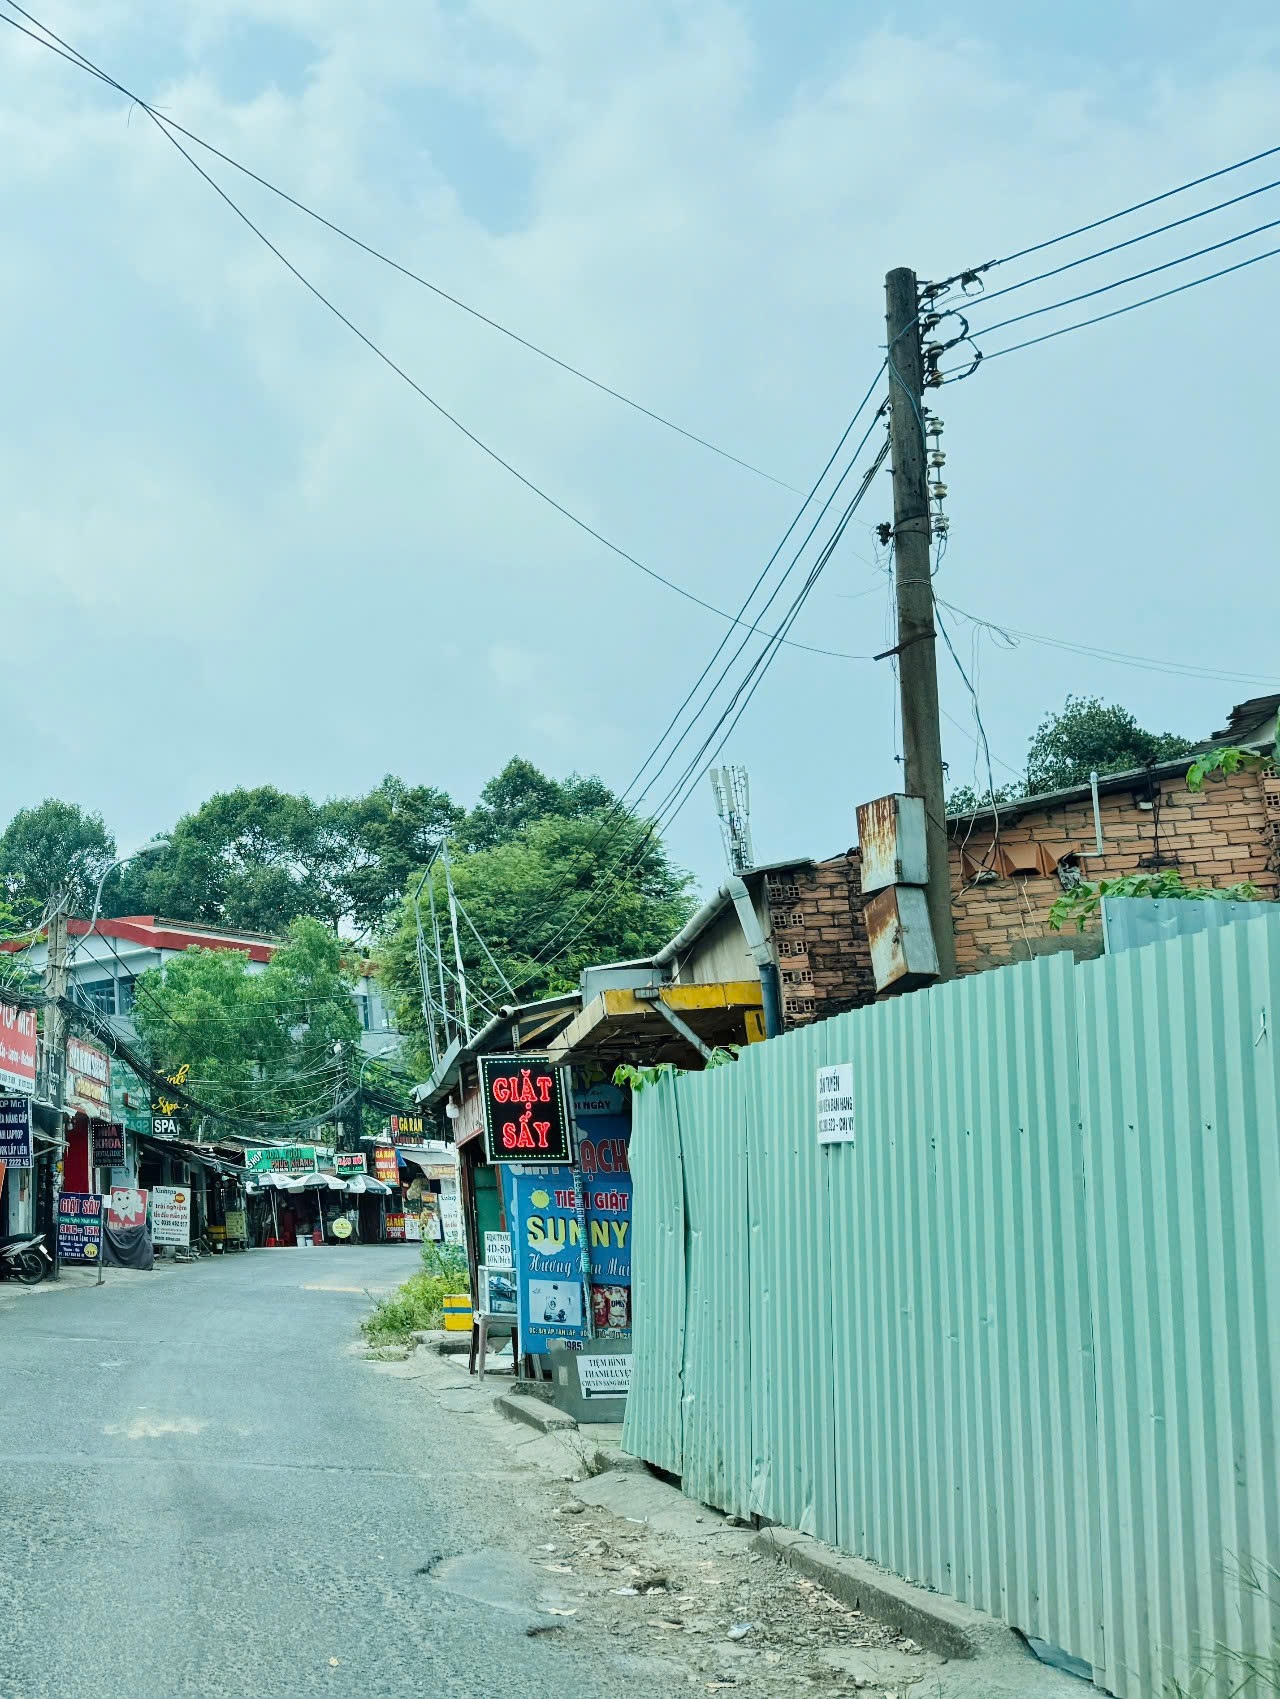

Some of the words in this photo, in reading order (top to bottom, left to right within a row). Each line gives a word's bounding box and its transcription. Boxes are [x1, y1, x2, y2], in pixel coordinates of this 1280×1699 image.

[493, 1068, 552, 1110] GIẶT
[10, 1099, 26, 1108] Mr.T
[154, 1119, 177, 1133] SPA
[503, 1111, 550, 1148] SẤY
[247, 1151, 263, 1169] SHOP
[569, 1138, 630, 1182] ẠCH
[60, 1196, 81, 1216] GIẶT
[593, 1188, 630, 1215] GIẶT
[84, 1225, 100, 1236] 15K
[526, 1214, 630, 1249] SUNNY
